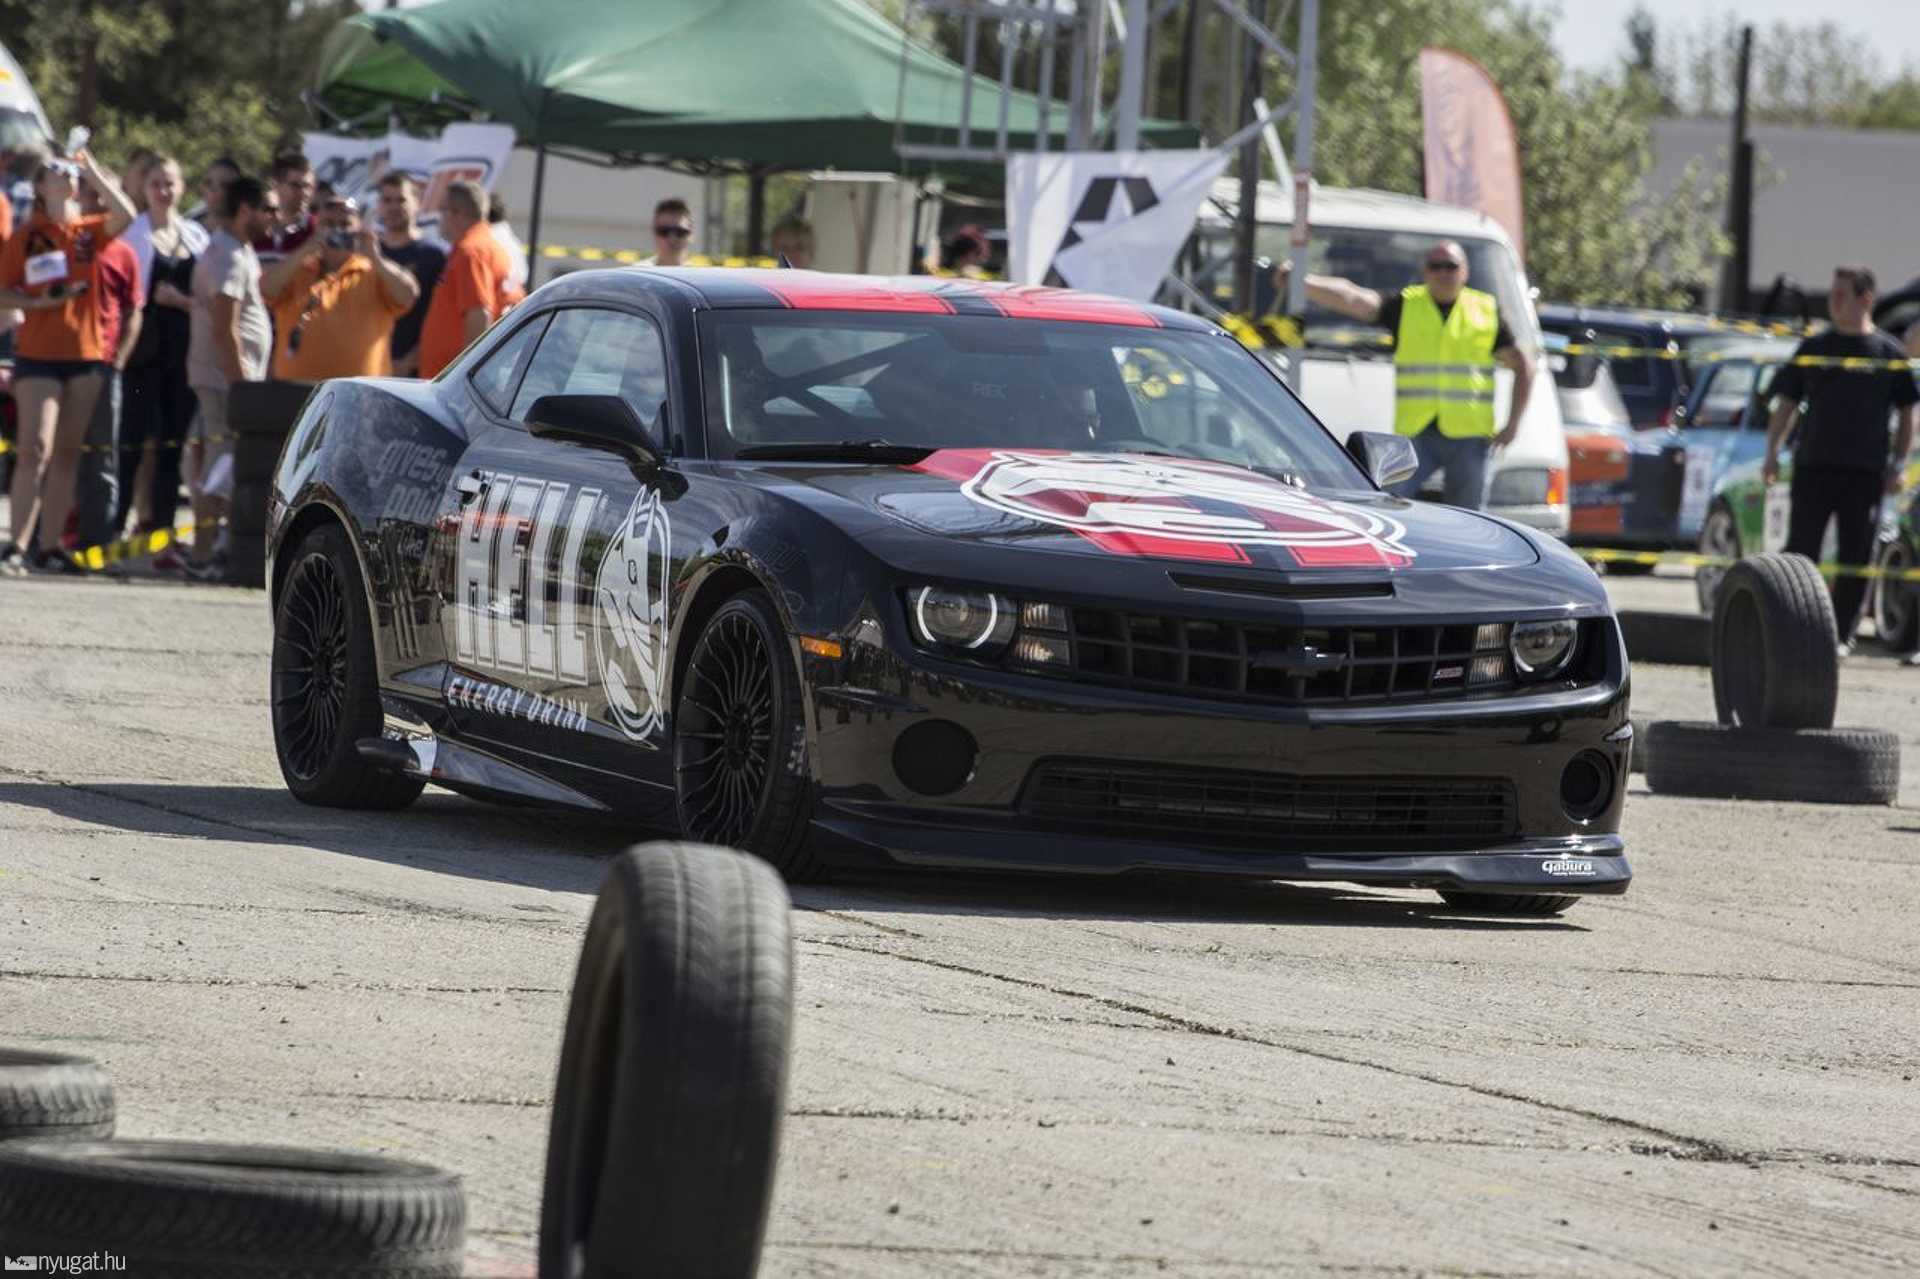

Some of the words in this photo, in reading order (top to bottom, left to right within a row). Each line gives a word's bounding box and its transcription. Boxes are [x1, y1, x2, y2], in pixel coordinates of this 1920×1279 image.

[455, 469, 601, 686] HELL
[447, 677, 526, 718] ENERGY
[527, 692, 588, 732] DRINK
